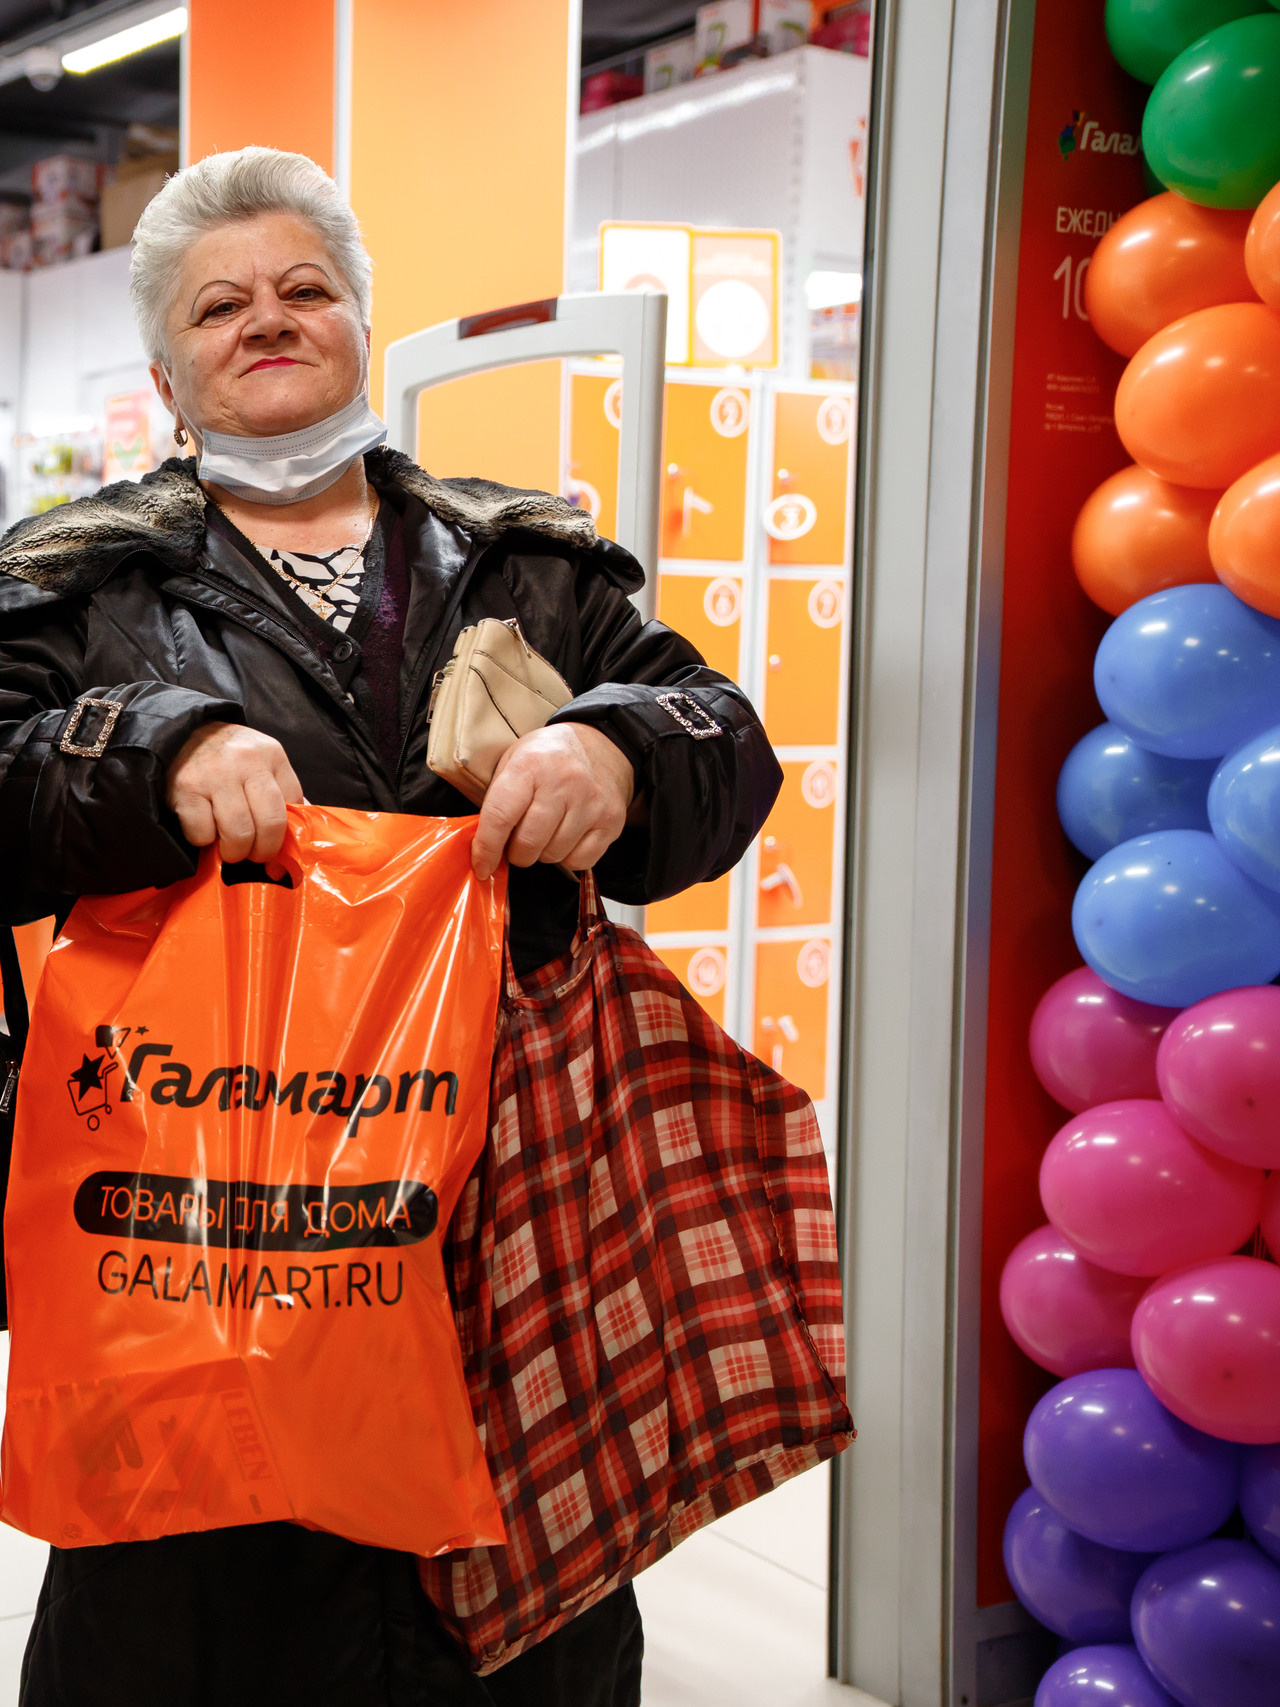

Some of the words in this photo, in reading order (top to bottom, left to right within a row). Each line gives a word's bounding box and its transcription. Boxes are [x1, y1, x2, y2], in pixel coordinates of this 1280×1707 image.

[120, 1043, 459, 1138] Галамарт
[101, 1186, 226, 1229] ТОВАРЫ
[234, 1197, 289, 1234] ДЛЯ
[303, 1196, 413, 1239] ДОМА
[98, 1250, 403, 1310] GALAMART.RU
